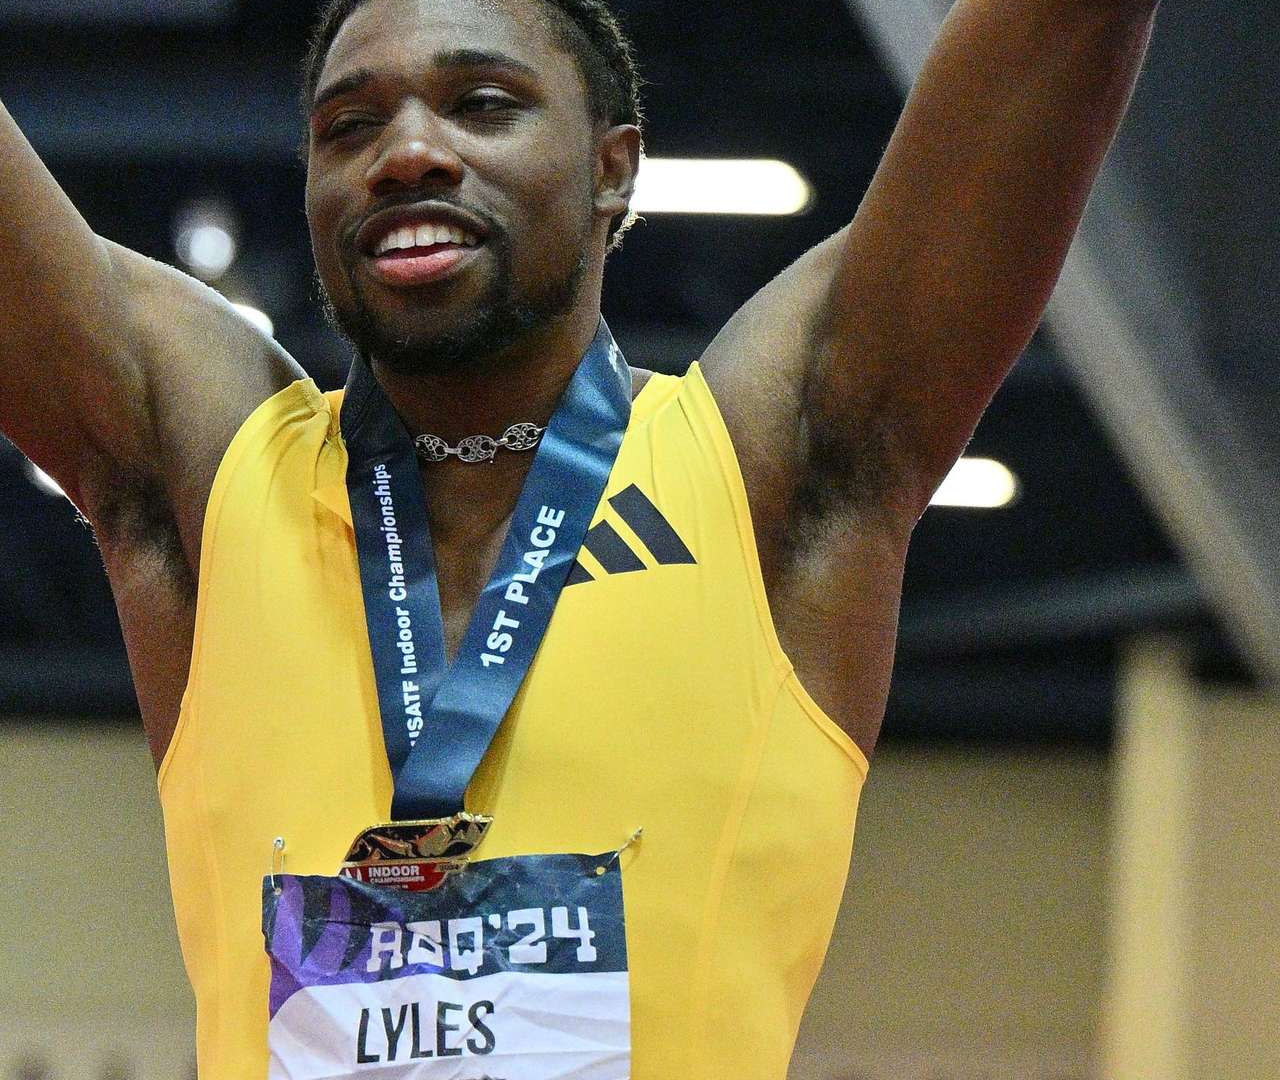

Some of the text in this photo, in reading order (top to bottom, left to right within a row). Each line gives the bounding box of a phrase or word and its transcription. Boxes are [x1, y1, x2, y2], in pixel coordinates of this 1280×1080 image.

[373, 463, 408, 601] Championships
[480, 505, 566, 667] 1ST PLACE
[395, 606, 418, 674] Indoor
[368, 865, 420, 877] INDOOR
[357, 999, 497, 1064] LYLES
